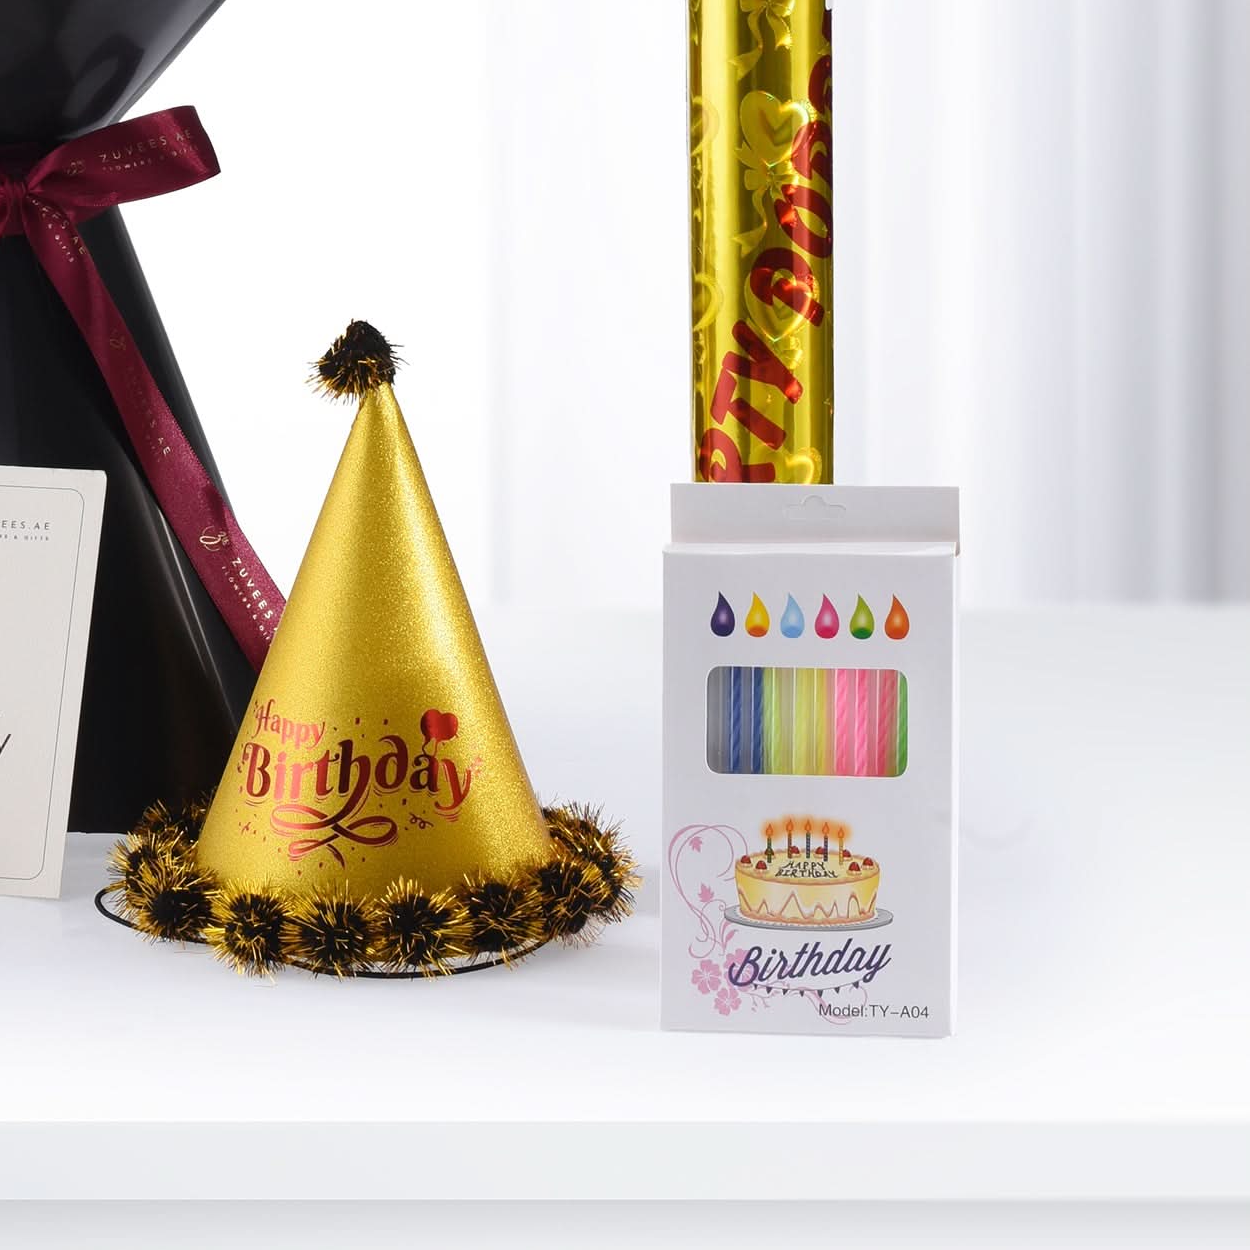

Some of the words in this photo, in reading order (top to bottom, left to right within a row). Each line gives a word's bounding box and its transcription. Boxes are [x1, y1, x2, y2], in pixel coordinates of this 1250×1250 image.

[249, 698, 326, 750] Happy
[243, 734, 472, 848] Birthday
[774, 868, 840, 879] BIRTHDAY
[781, 860, 826, 871] HAPPY
[727, 937, 893, 988] Birthday
